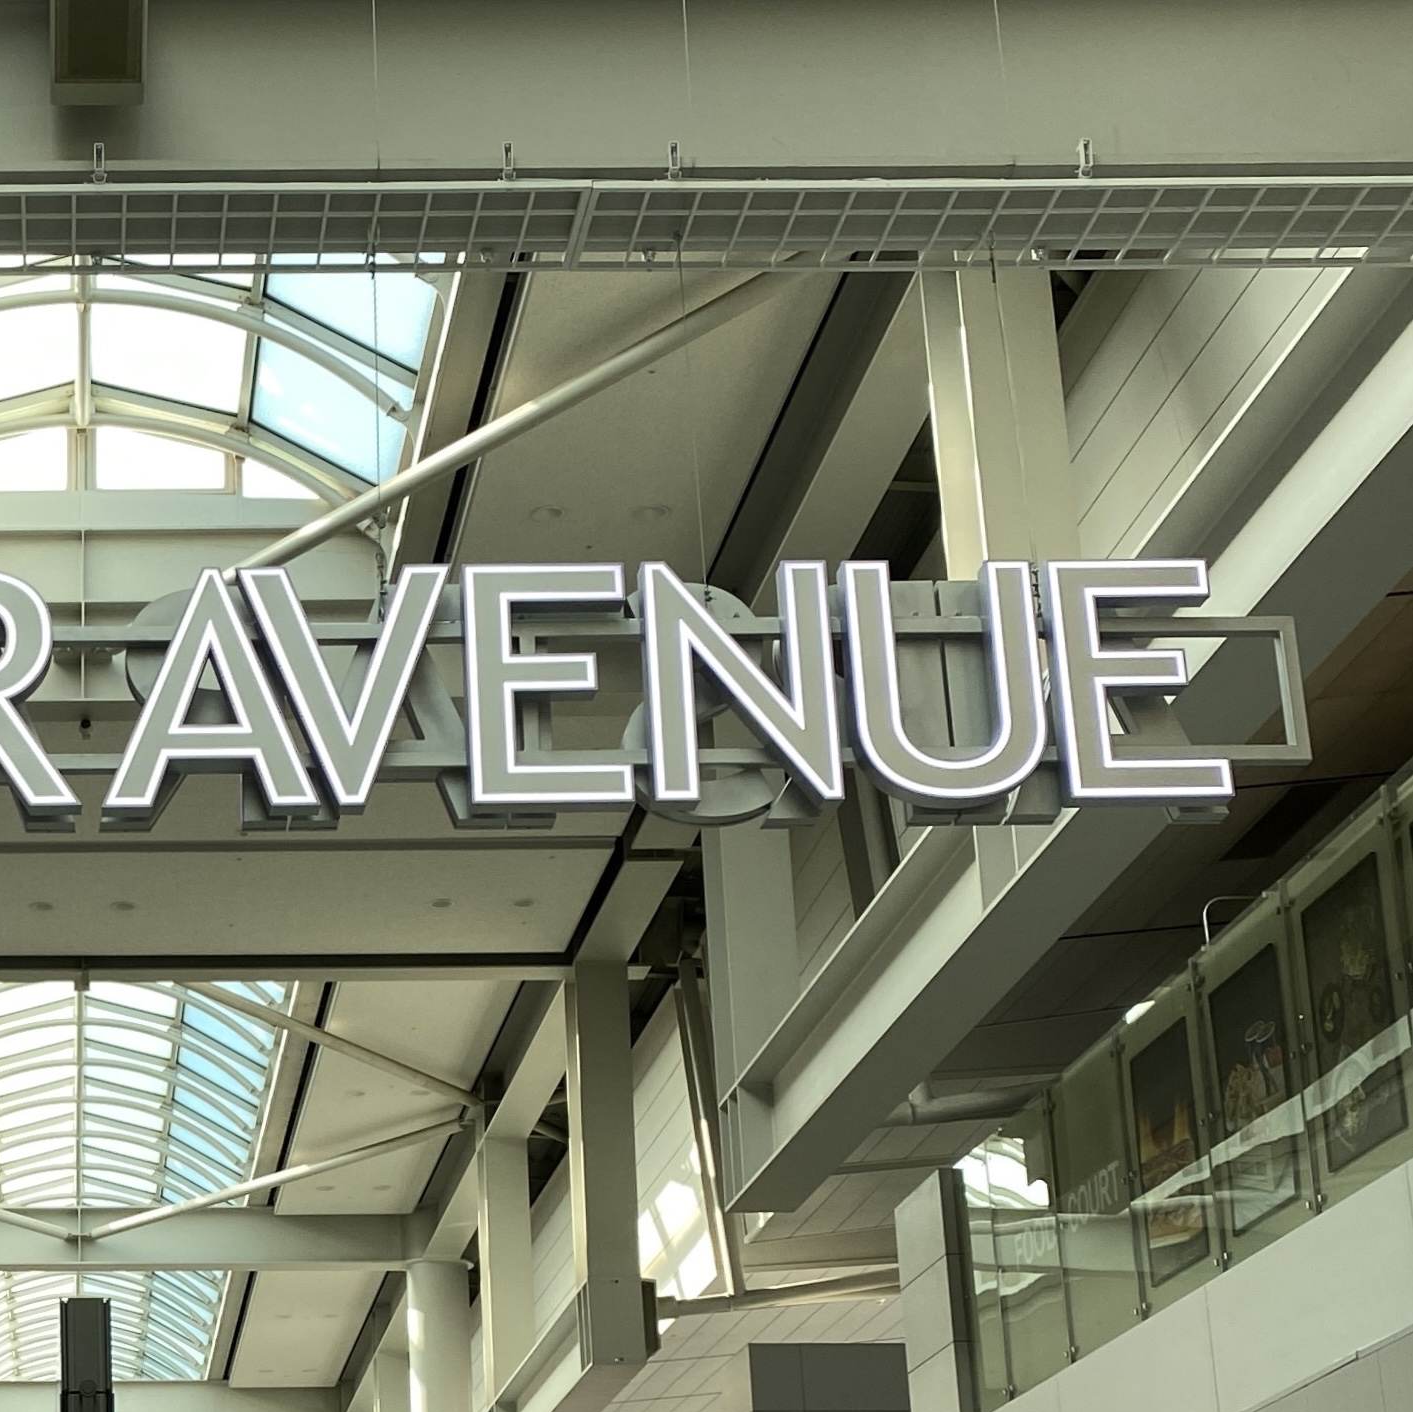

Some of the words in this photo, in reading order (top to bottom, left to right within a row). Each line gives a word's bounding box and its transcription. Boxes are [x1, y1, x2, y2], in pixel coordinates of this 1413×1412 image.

[105, 559, 1234, 805] AVENUE
[1015, 1216, 1057, 1270] FOOD
[1068, 1160, 1119, 1233] COURT
